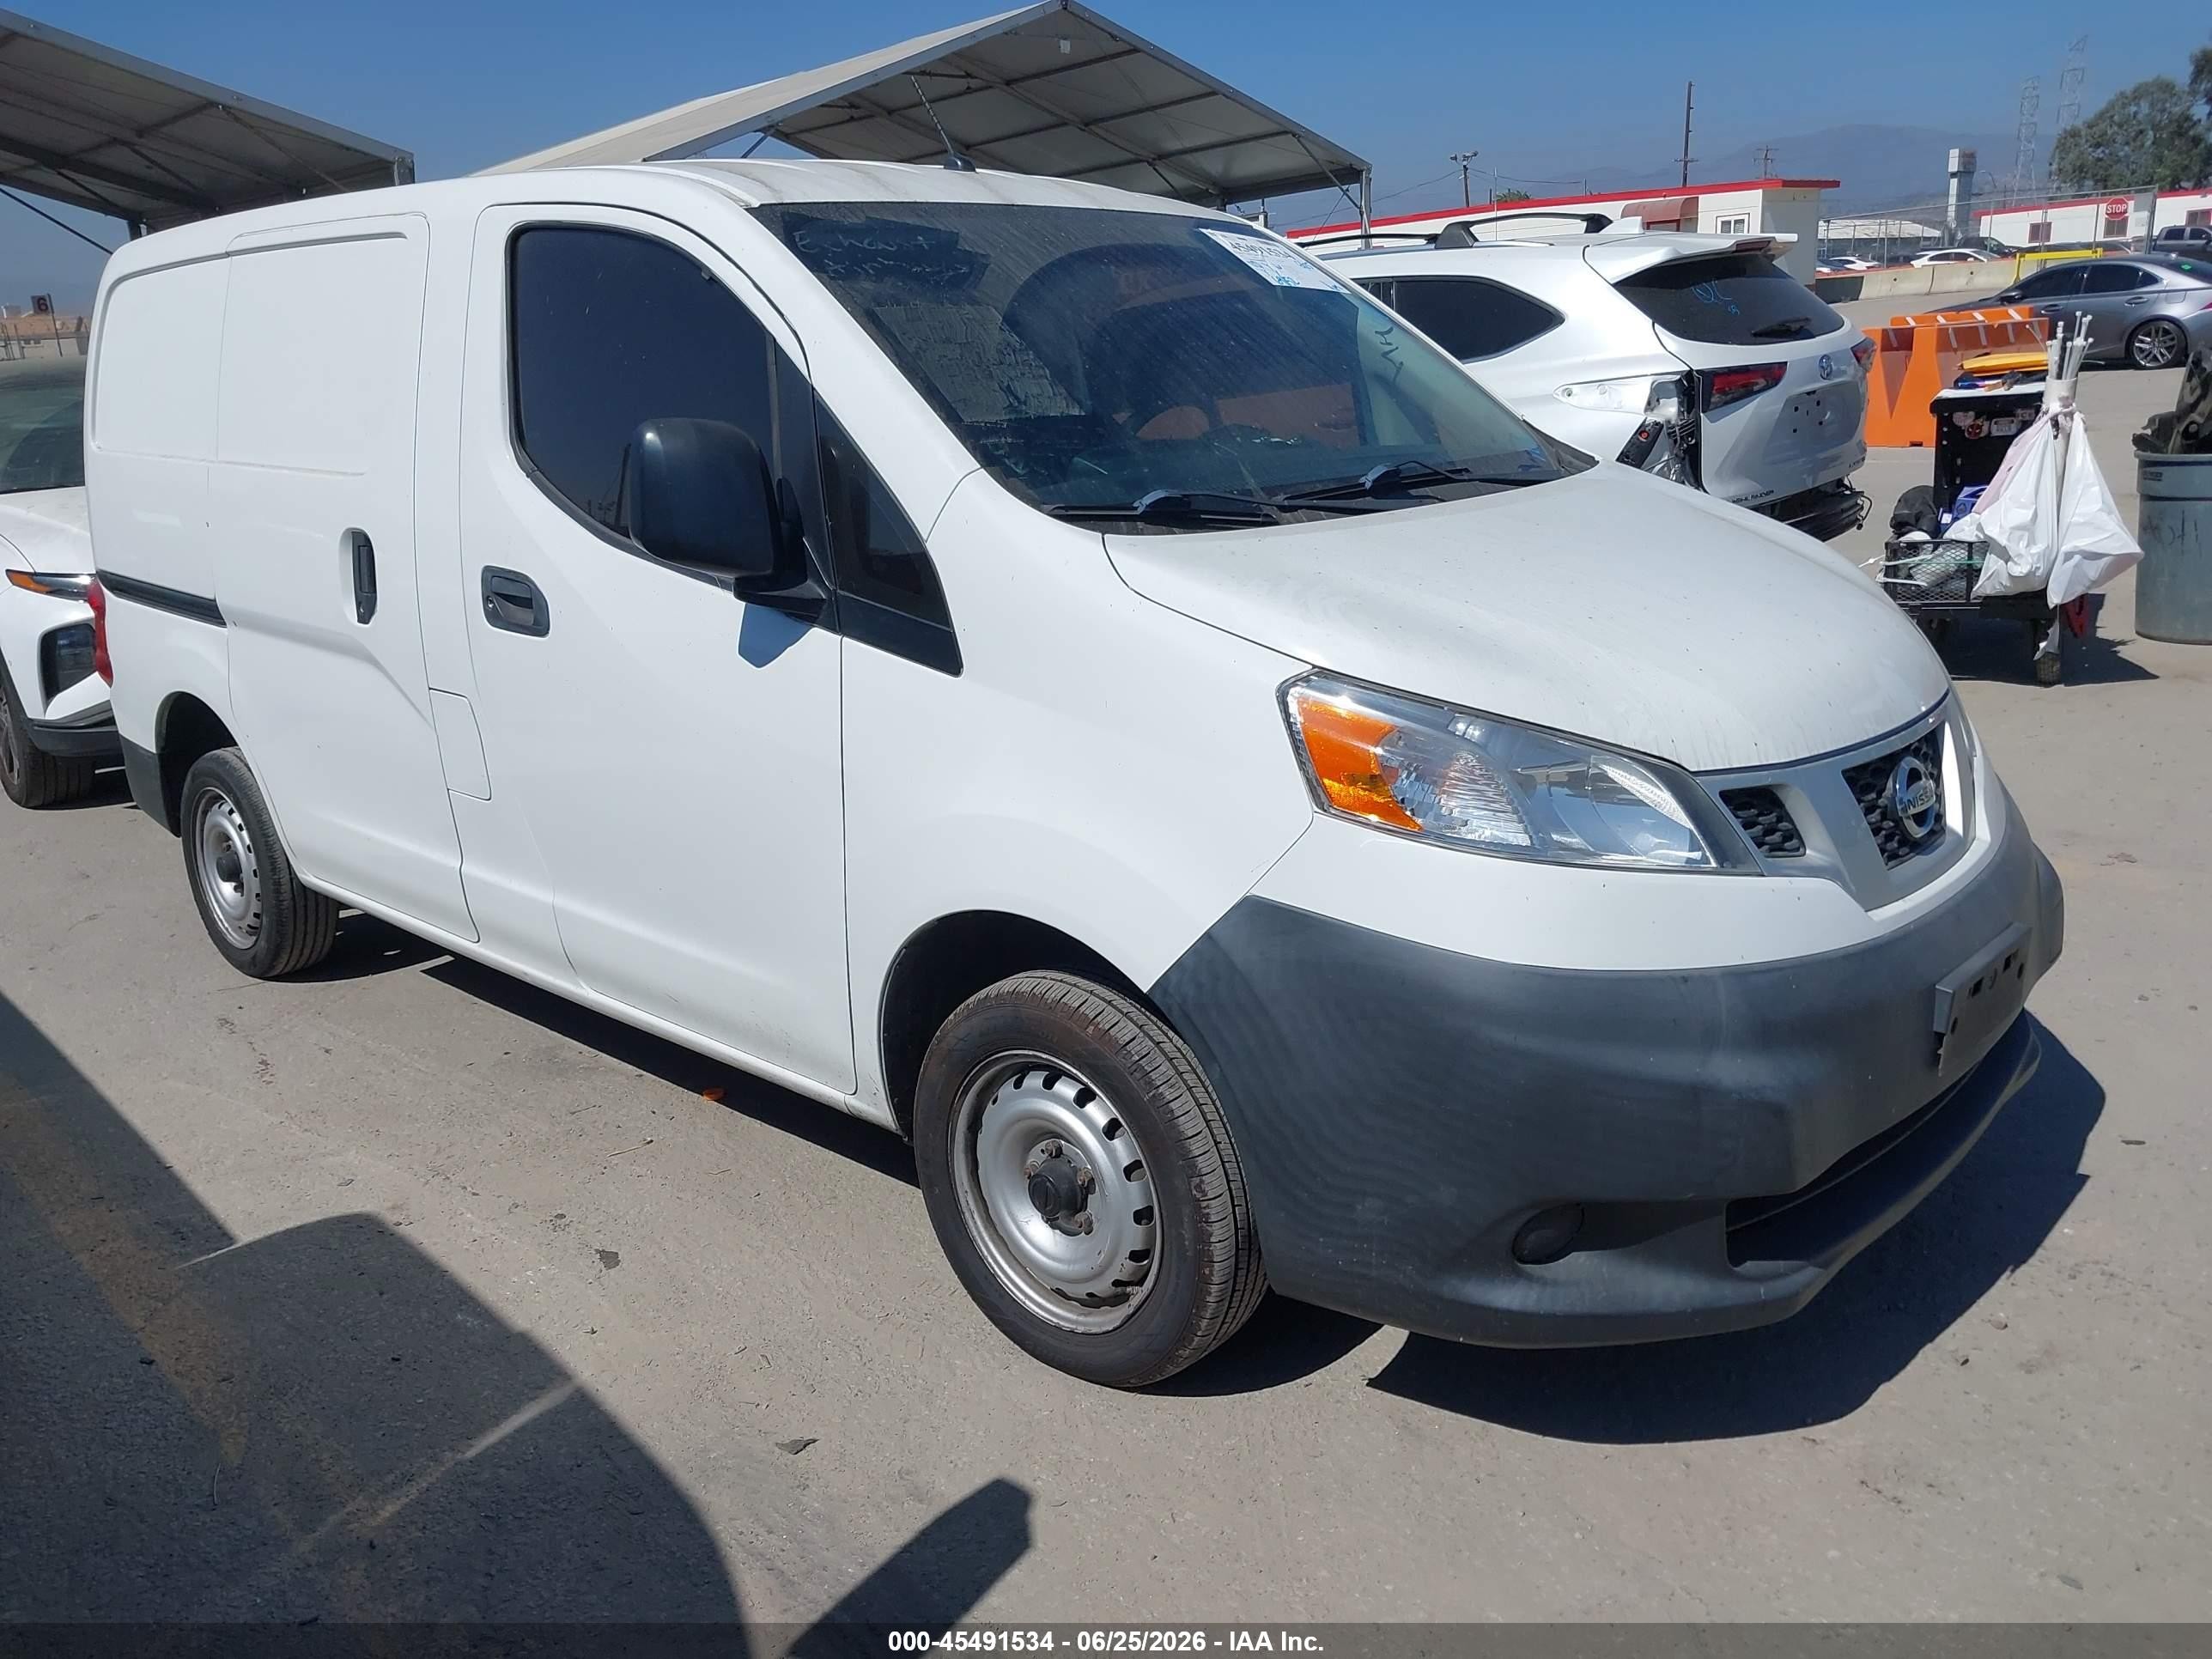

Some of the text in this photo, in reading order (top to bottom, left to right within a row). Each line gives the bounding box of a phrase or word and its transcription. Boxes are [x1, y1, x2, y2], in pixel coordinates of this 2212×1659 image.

[2106, 204, 2127, 214] STOP
[37, 297, 49, 312] 6
[1905, 781, 1933, 811] NISS
